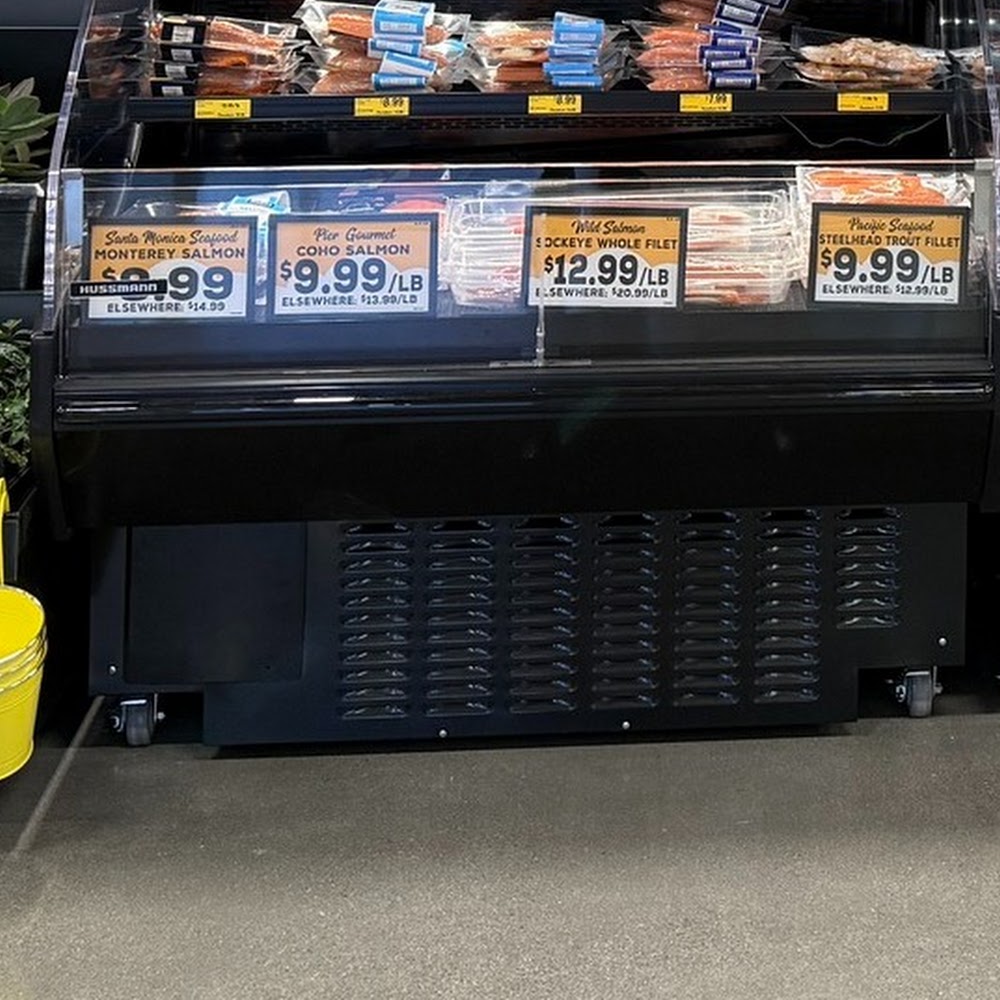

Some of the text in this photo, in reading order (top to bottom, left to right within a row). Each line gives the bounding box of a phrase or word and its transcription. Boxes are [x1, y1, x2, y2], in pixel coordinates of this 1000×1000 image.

[314, 226, 397, 242] Pier Gourmet
[571, 219, 645, 235] Wild Salmon
[848, 217, 935, 236] Pacific Seafood
[105, 230, 239, 247] Santa Monica Seafood
[597, 237, 641, 249] WHOLE
[645, 238, 678, 250] FILET
[819, 234, 960, 248] STEELHEAD TROUT FILLET
[94, 247, 245, 260] MONTEREY SALMON
[296, 244, 410, 257] COHO SALMON
[544, 253, 669, 286] $12.99/LB
[820, 247, 954, 284] $9.99/LB
[280, 258, 423, 294] $9.99/LB
